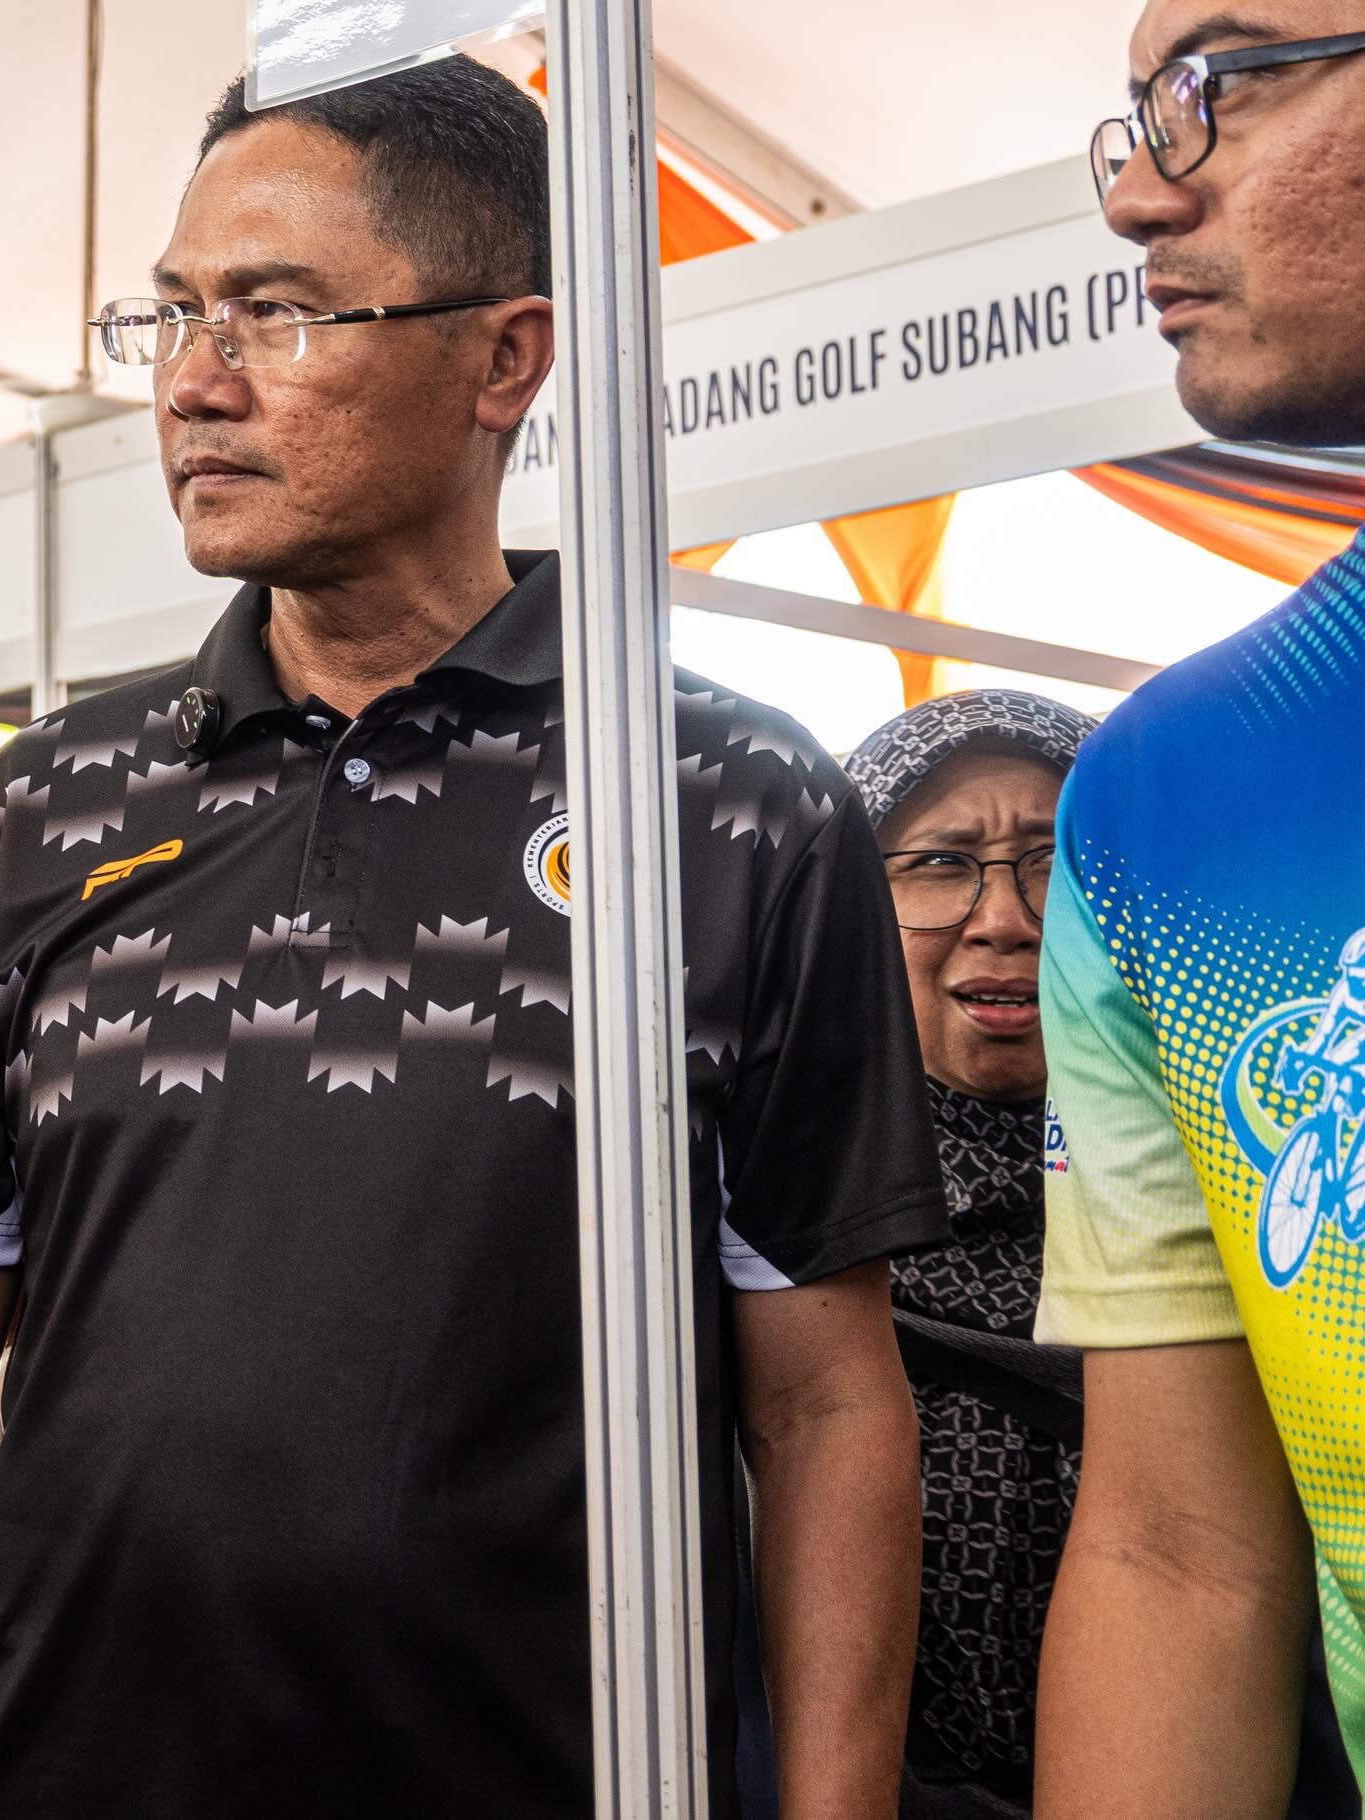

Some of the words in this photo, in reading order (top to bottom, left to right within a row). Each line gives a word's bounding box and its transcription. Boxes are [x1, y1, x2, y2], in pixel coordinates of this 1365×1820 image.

[664, 356, 780, 437] ADANG
[795, 331, 887, 406] GOLF
[901, 284, 1069, 381] SUBANG
[527, 816, 569, 868] KEMENTERIAN
[534, 882, 565, 910] SPORTS
